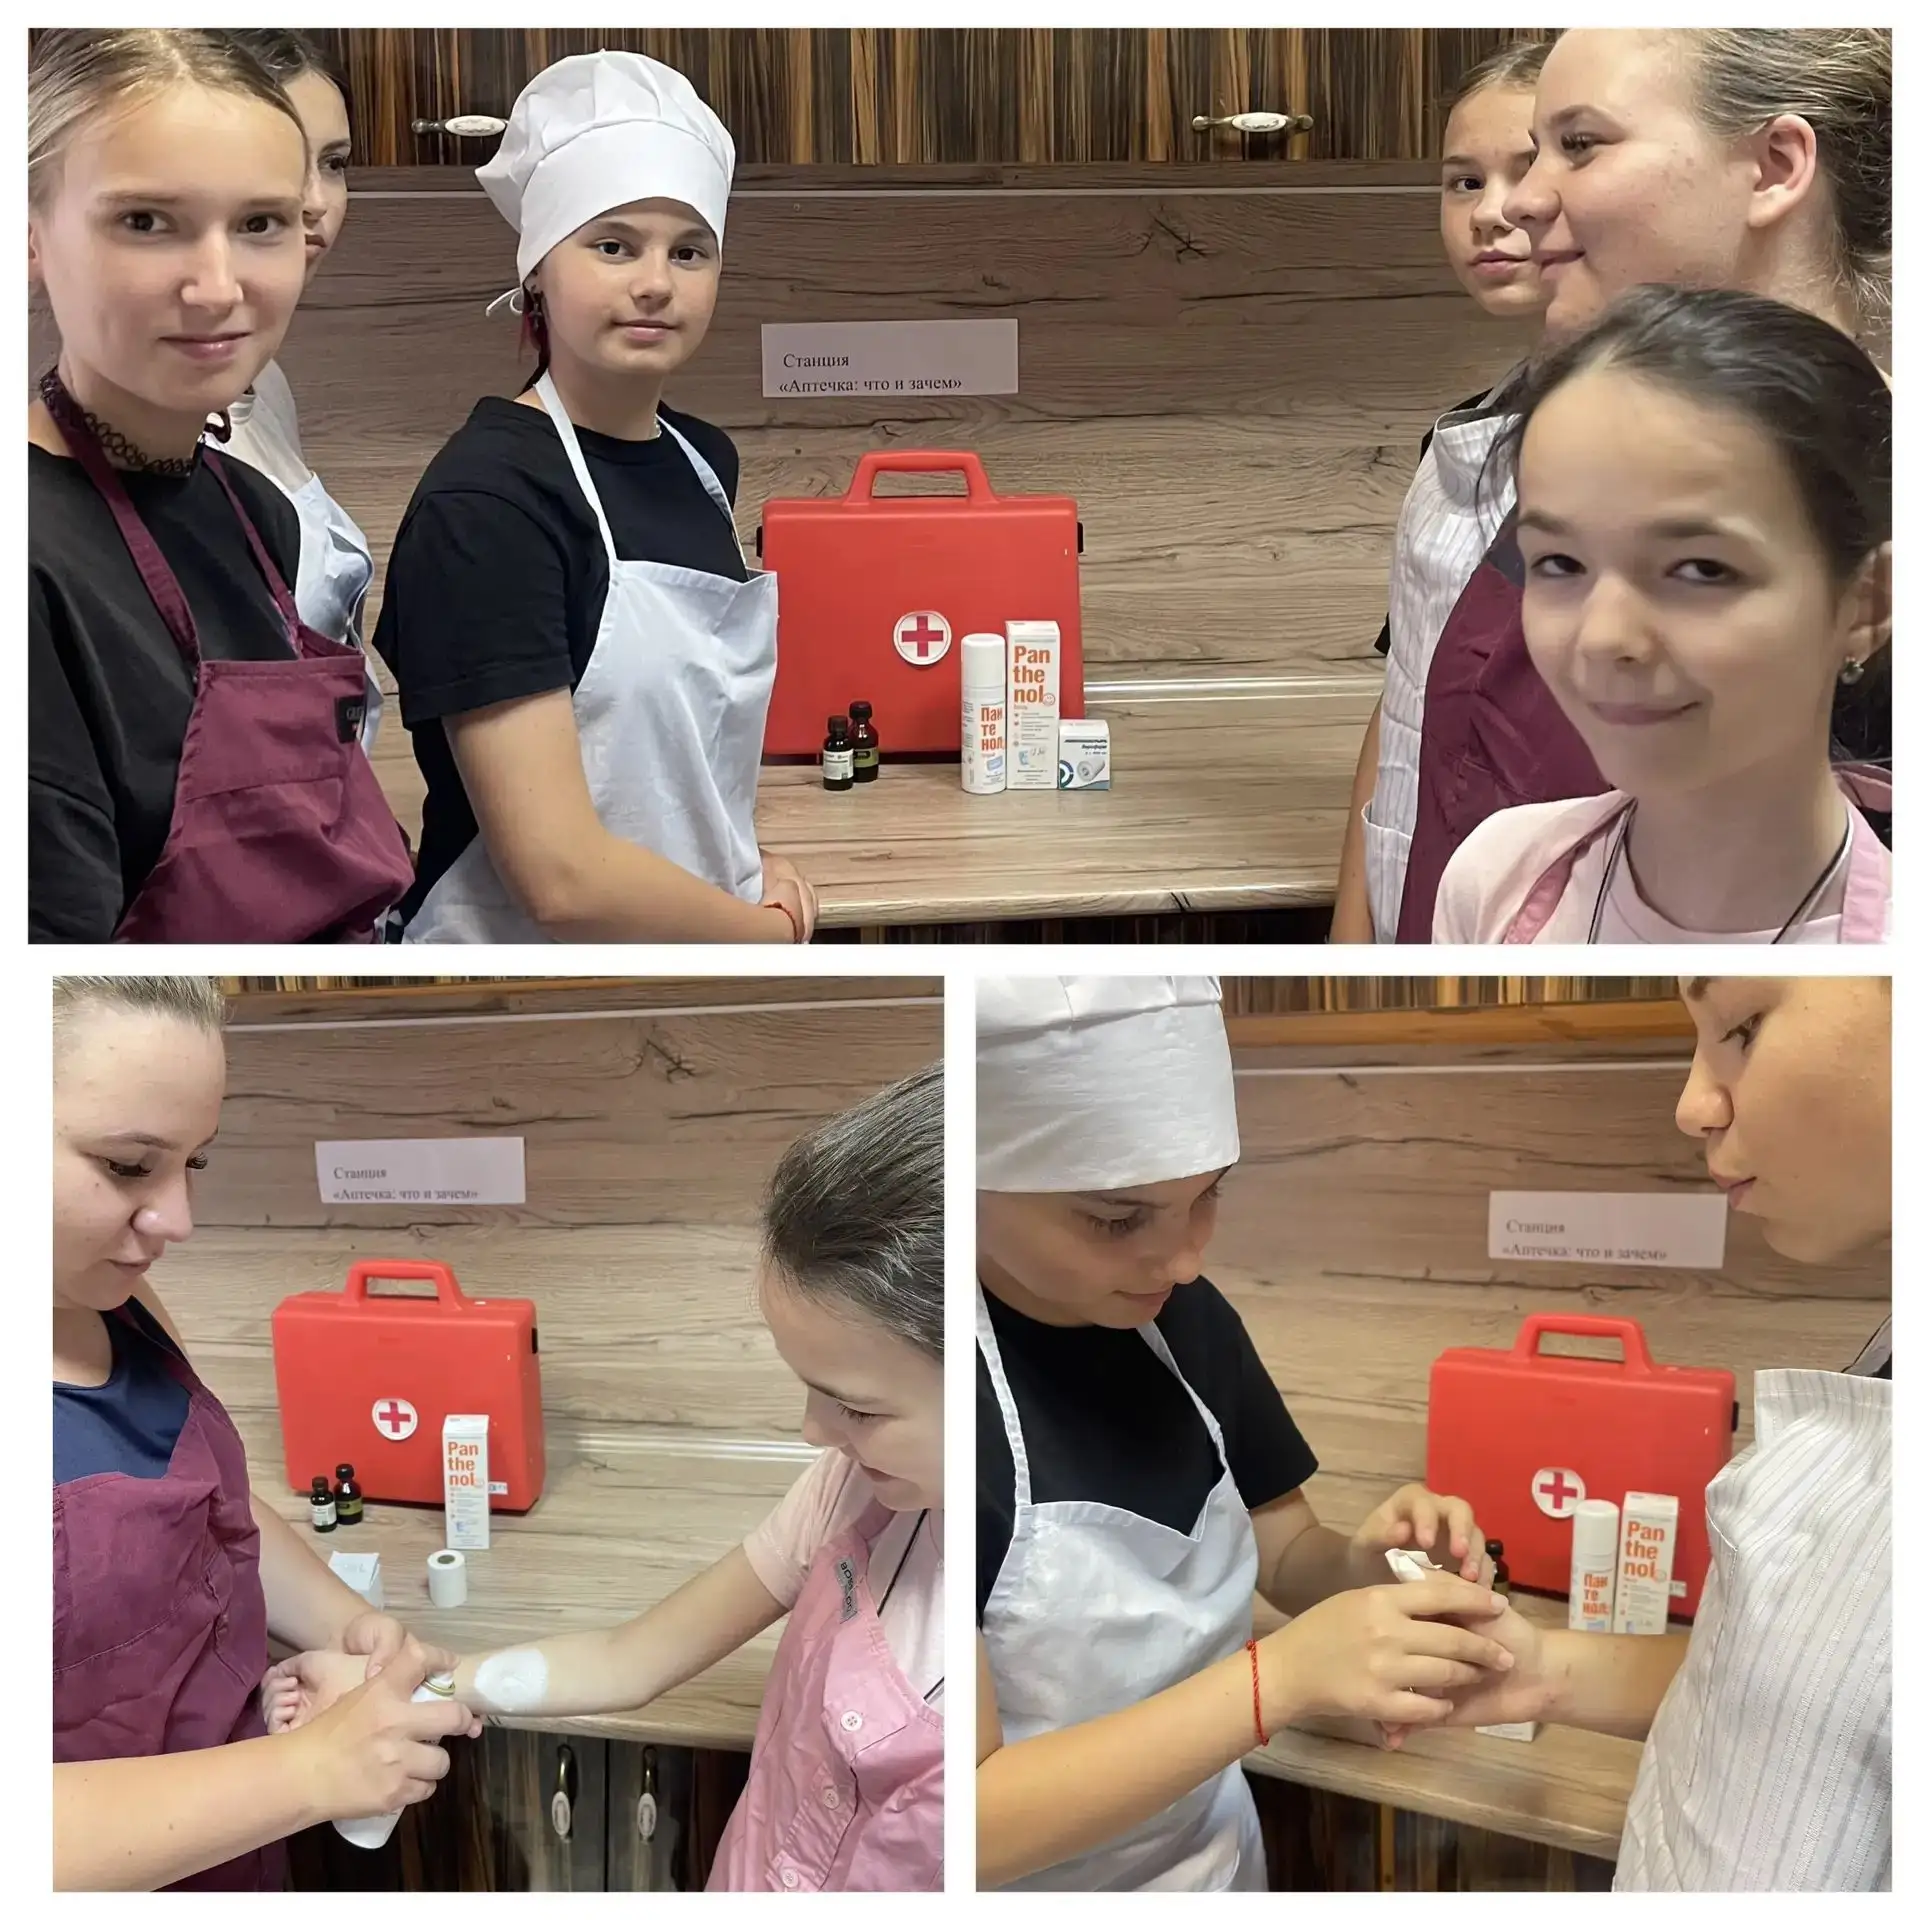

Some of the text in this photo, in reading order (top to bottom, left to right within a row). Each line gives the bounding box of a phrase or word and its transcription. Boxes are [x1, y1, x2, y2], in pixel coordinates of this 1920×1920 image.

[783, 353, 849, 368] Станция
[779, 379, 962, 393] «Аптечка: что и зачем»
[1014, 645, 1051, 664] Pan
[1013, 665, 1045, 684] the
[1014, 685, 1044, 703] nol
[981, 706, 1003, 722] Пан
[981, 723, 996, 736] те
[981, 737, 1003, 751] нол
[333, 1167, 387, 1180] Станция
[399, 1190, 420, 1200] что
[424, 1190, 432, 1200] и
[1576, 1247, 1600, 1259] что
[1604, 1249, 1614, 1259] и
[448, 1442, 479, 1456] Pan
[447, 1457, 476, 1471] the
[449, 1473, 475, 1486] nol
[1627, 1521, 1665, 1542] Pan
[1625, 1540, 1658, 1559] the
[1623, 1561, 1656, 1578] nol
